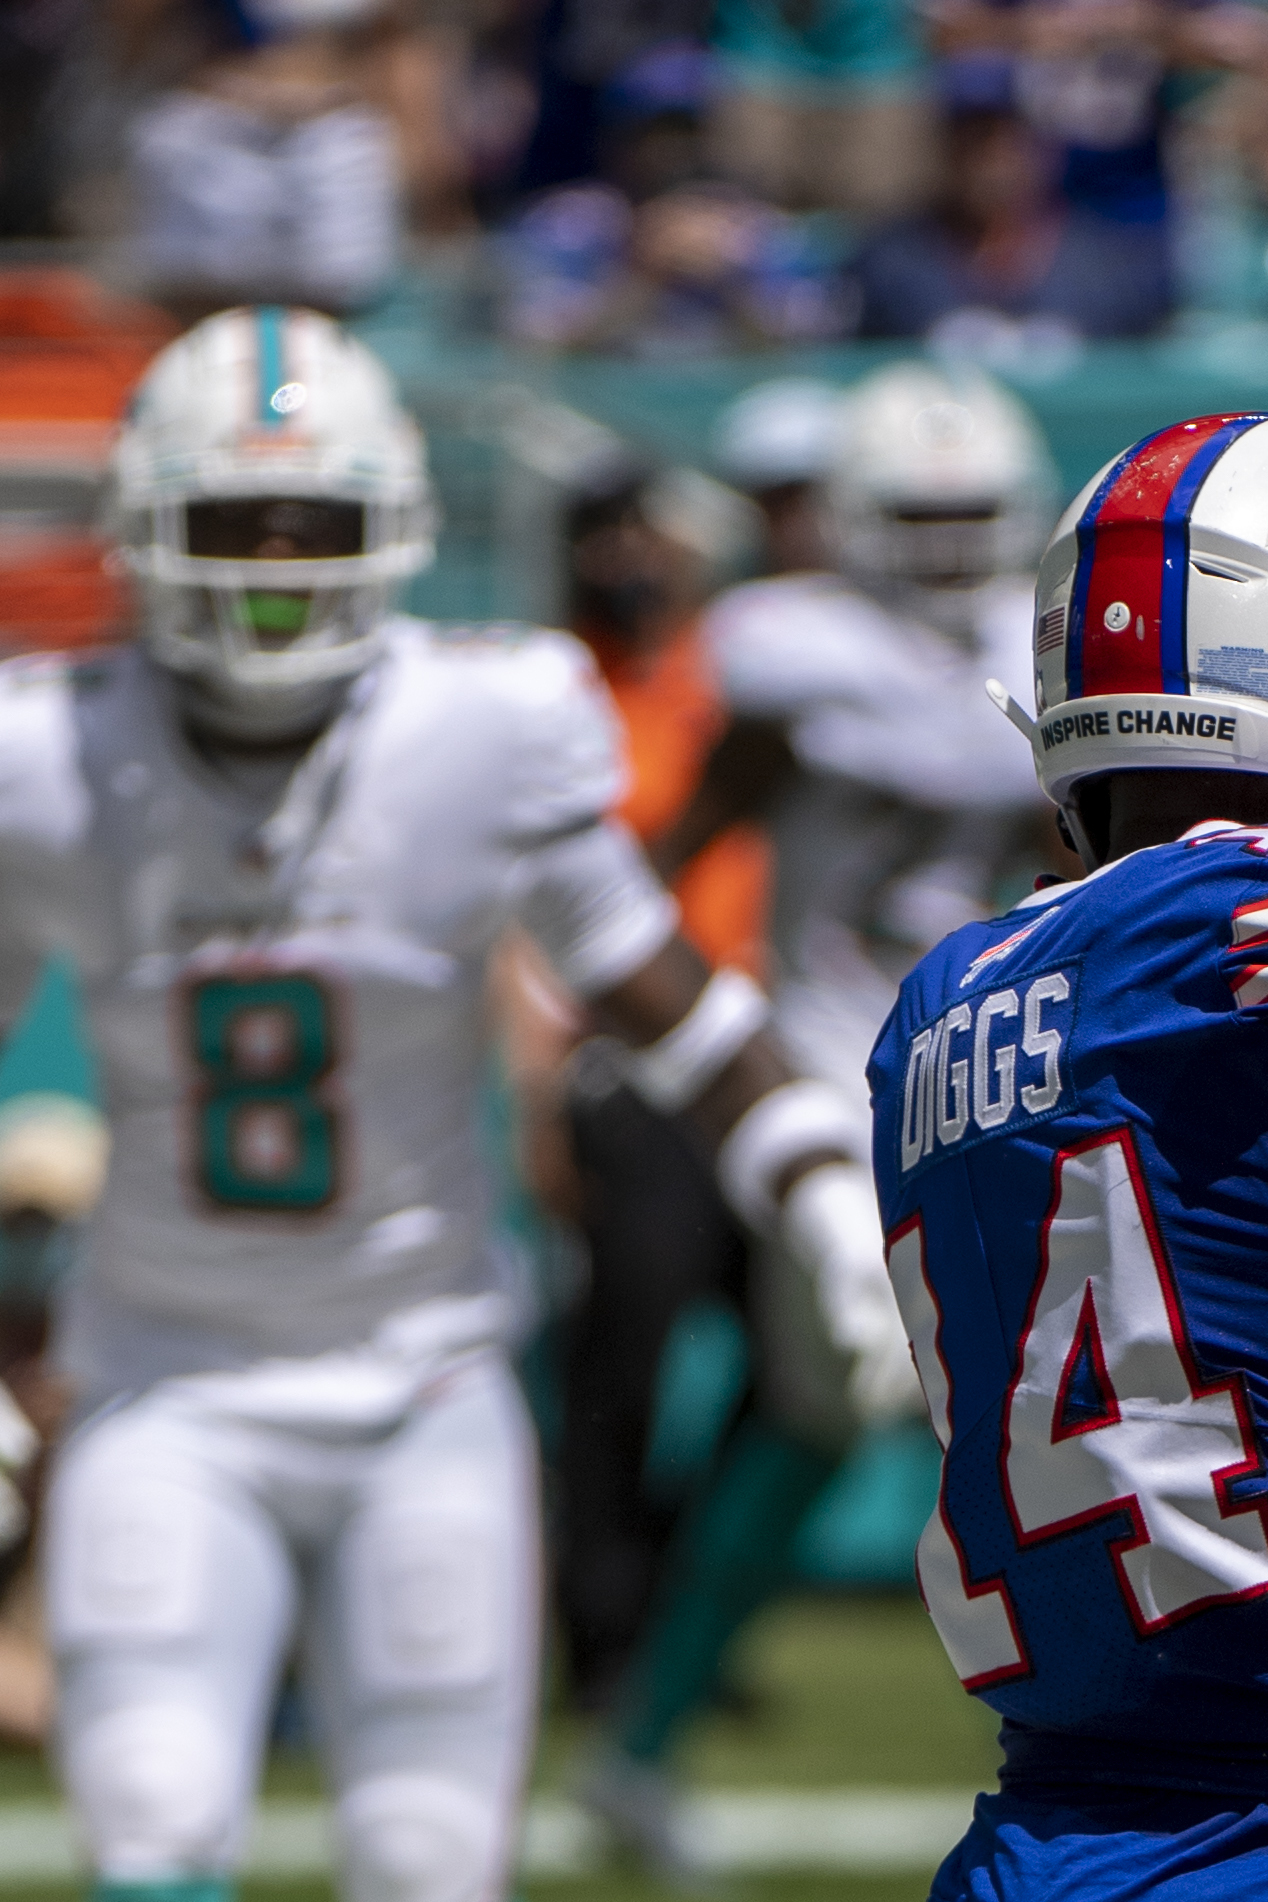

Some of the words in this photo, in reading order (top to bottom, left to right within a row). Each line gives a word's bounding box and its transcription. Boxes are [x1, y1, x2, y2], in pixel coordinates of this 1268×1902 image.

[1041, 711, 1110, 751] INSPIRE
[1117, 710, 1236, 742] CHANGE
[167, 955, 360, 1232] 8
[901, 972, 1070, 1173] DIGGS
